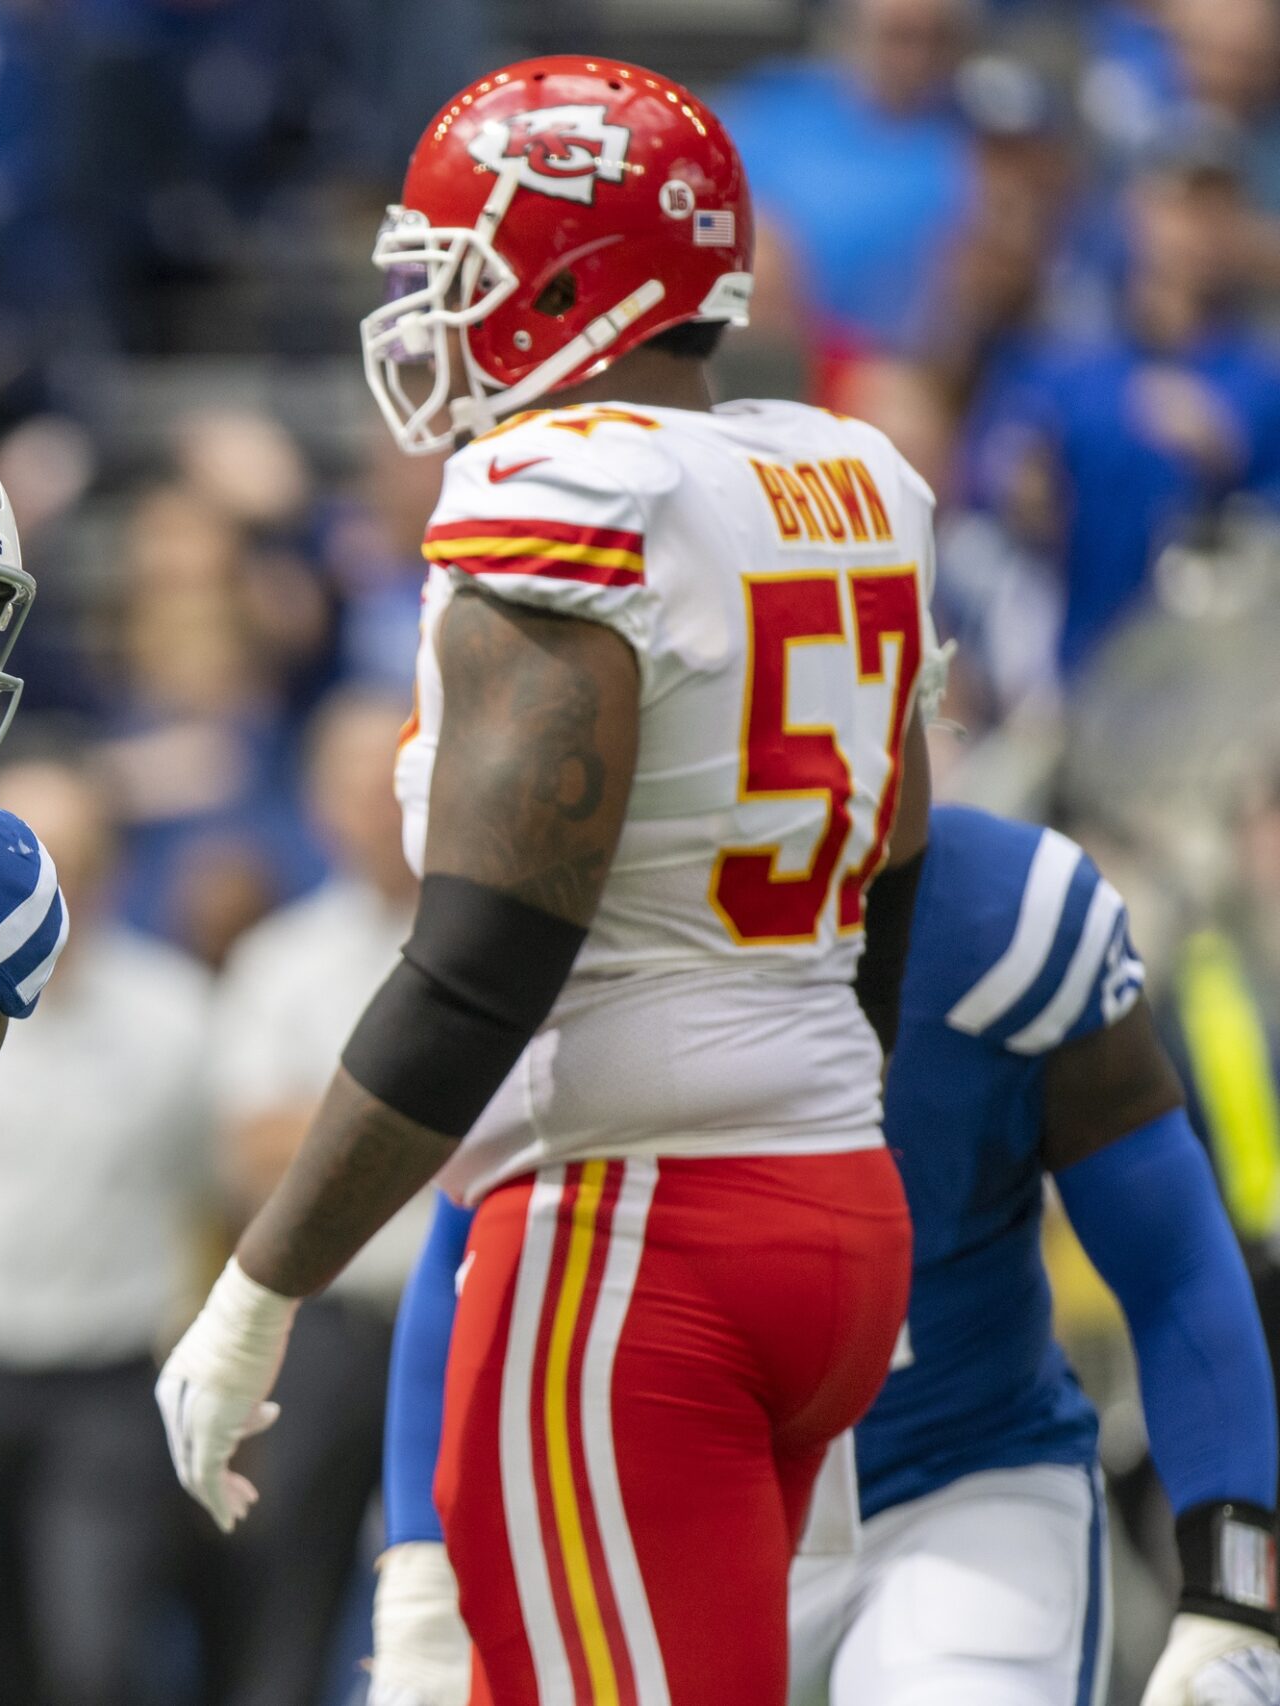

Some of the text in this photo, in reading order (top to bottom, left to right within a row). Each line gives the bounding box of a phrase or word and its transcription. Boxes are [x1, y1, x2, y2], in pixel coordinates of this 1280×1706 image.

[669, 187, 688, 211] 16
[748, 457, 894, 543] BROWN
[708, 562, 923, 946] 57
